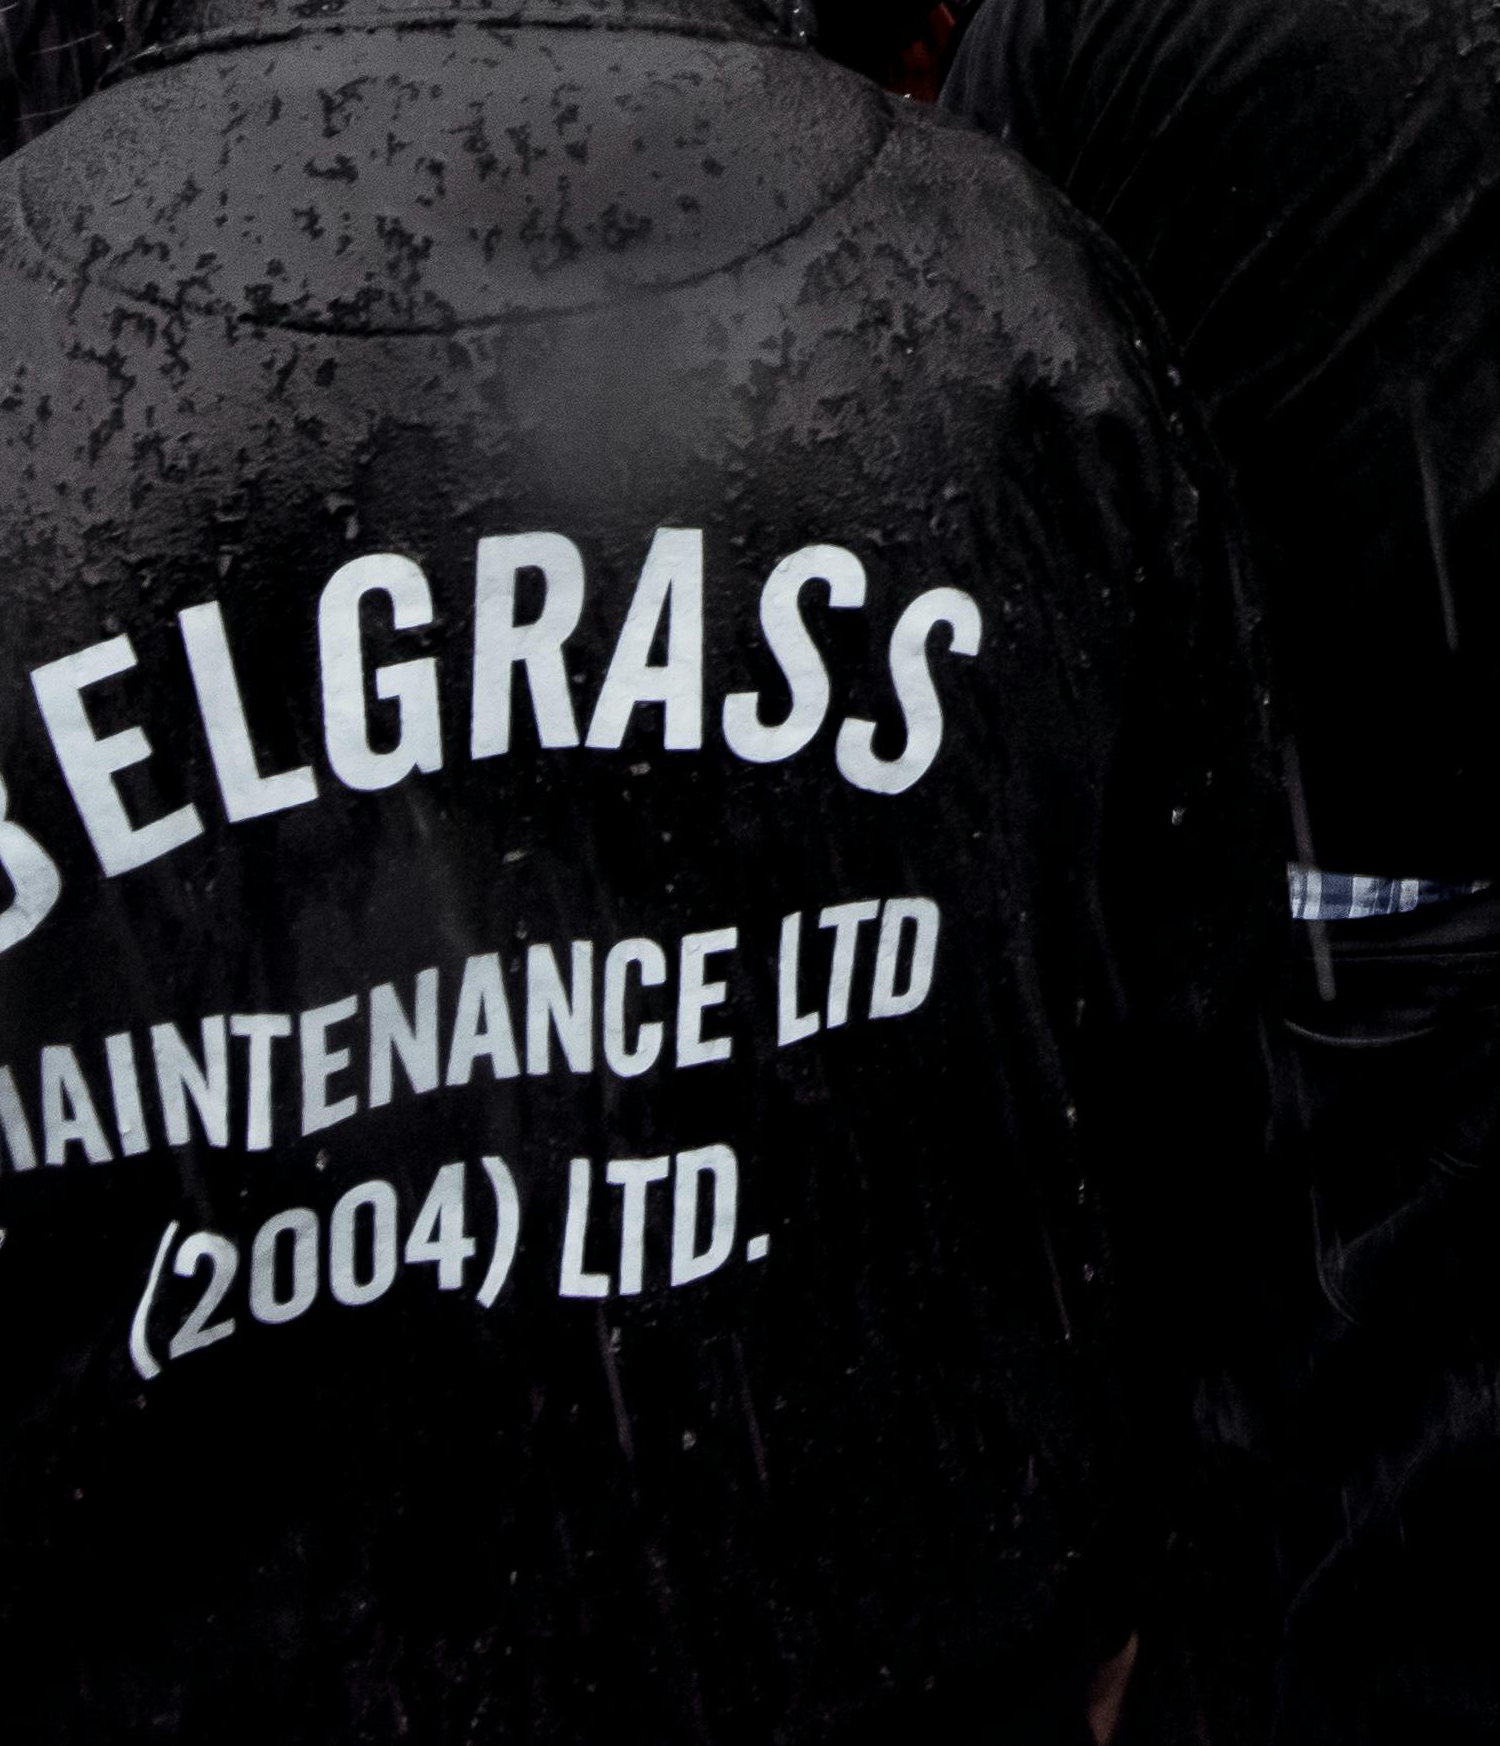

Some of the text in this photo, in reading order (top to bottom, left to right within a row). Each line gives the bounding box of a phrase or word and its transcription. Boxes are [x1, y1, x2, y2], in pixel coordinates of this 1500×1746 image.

[777, 897, 940, 1047] LTD
[129, 1143, 771, 1380] (2004) LTD.
